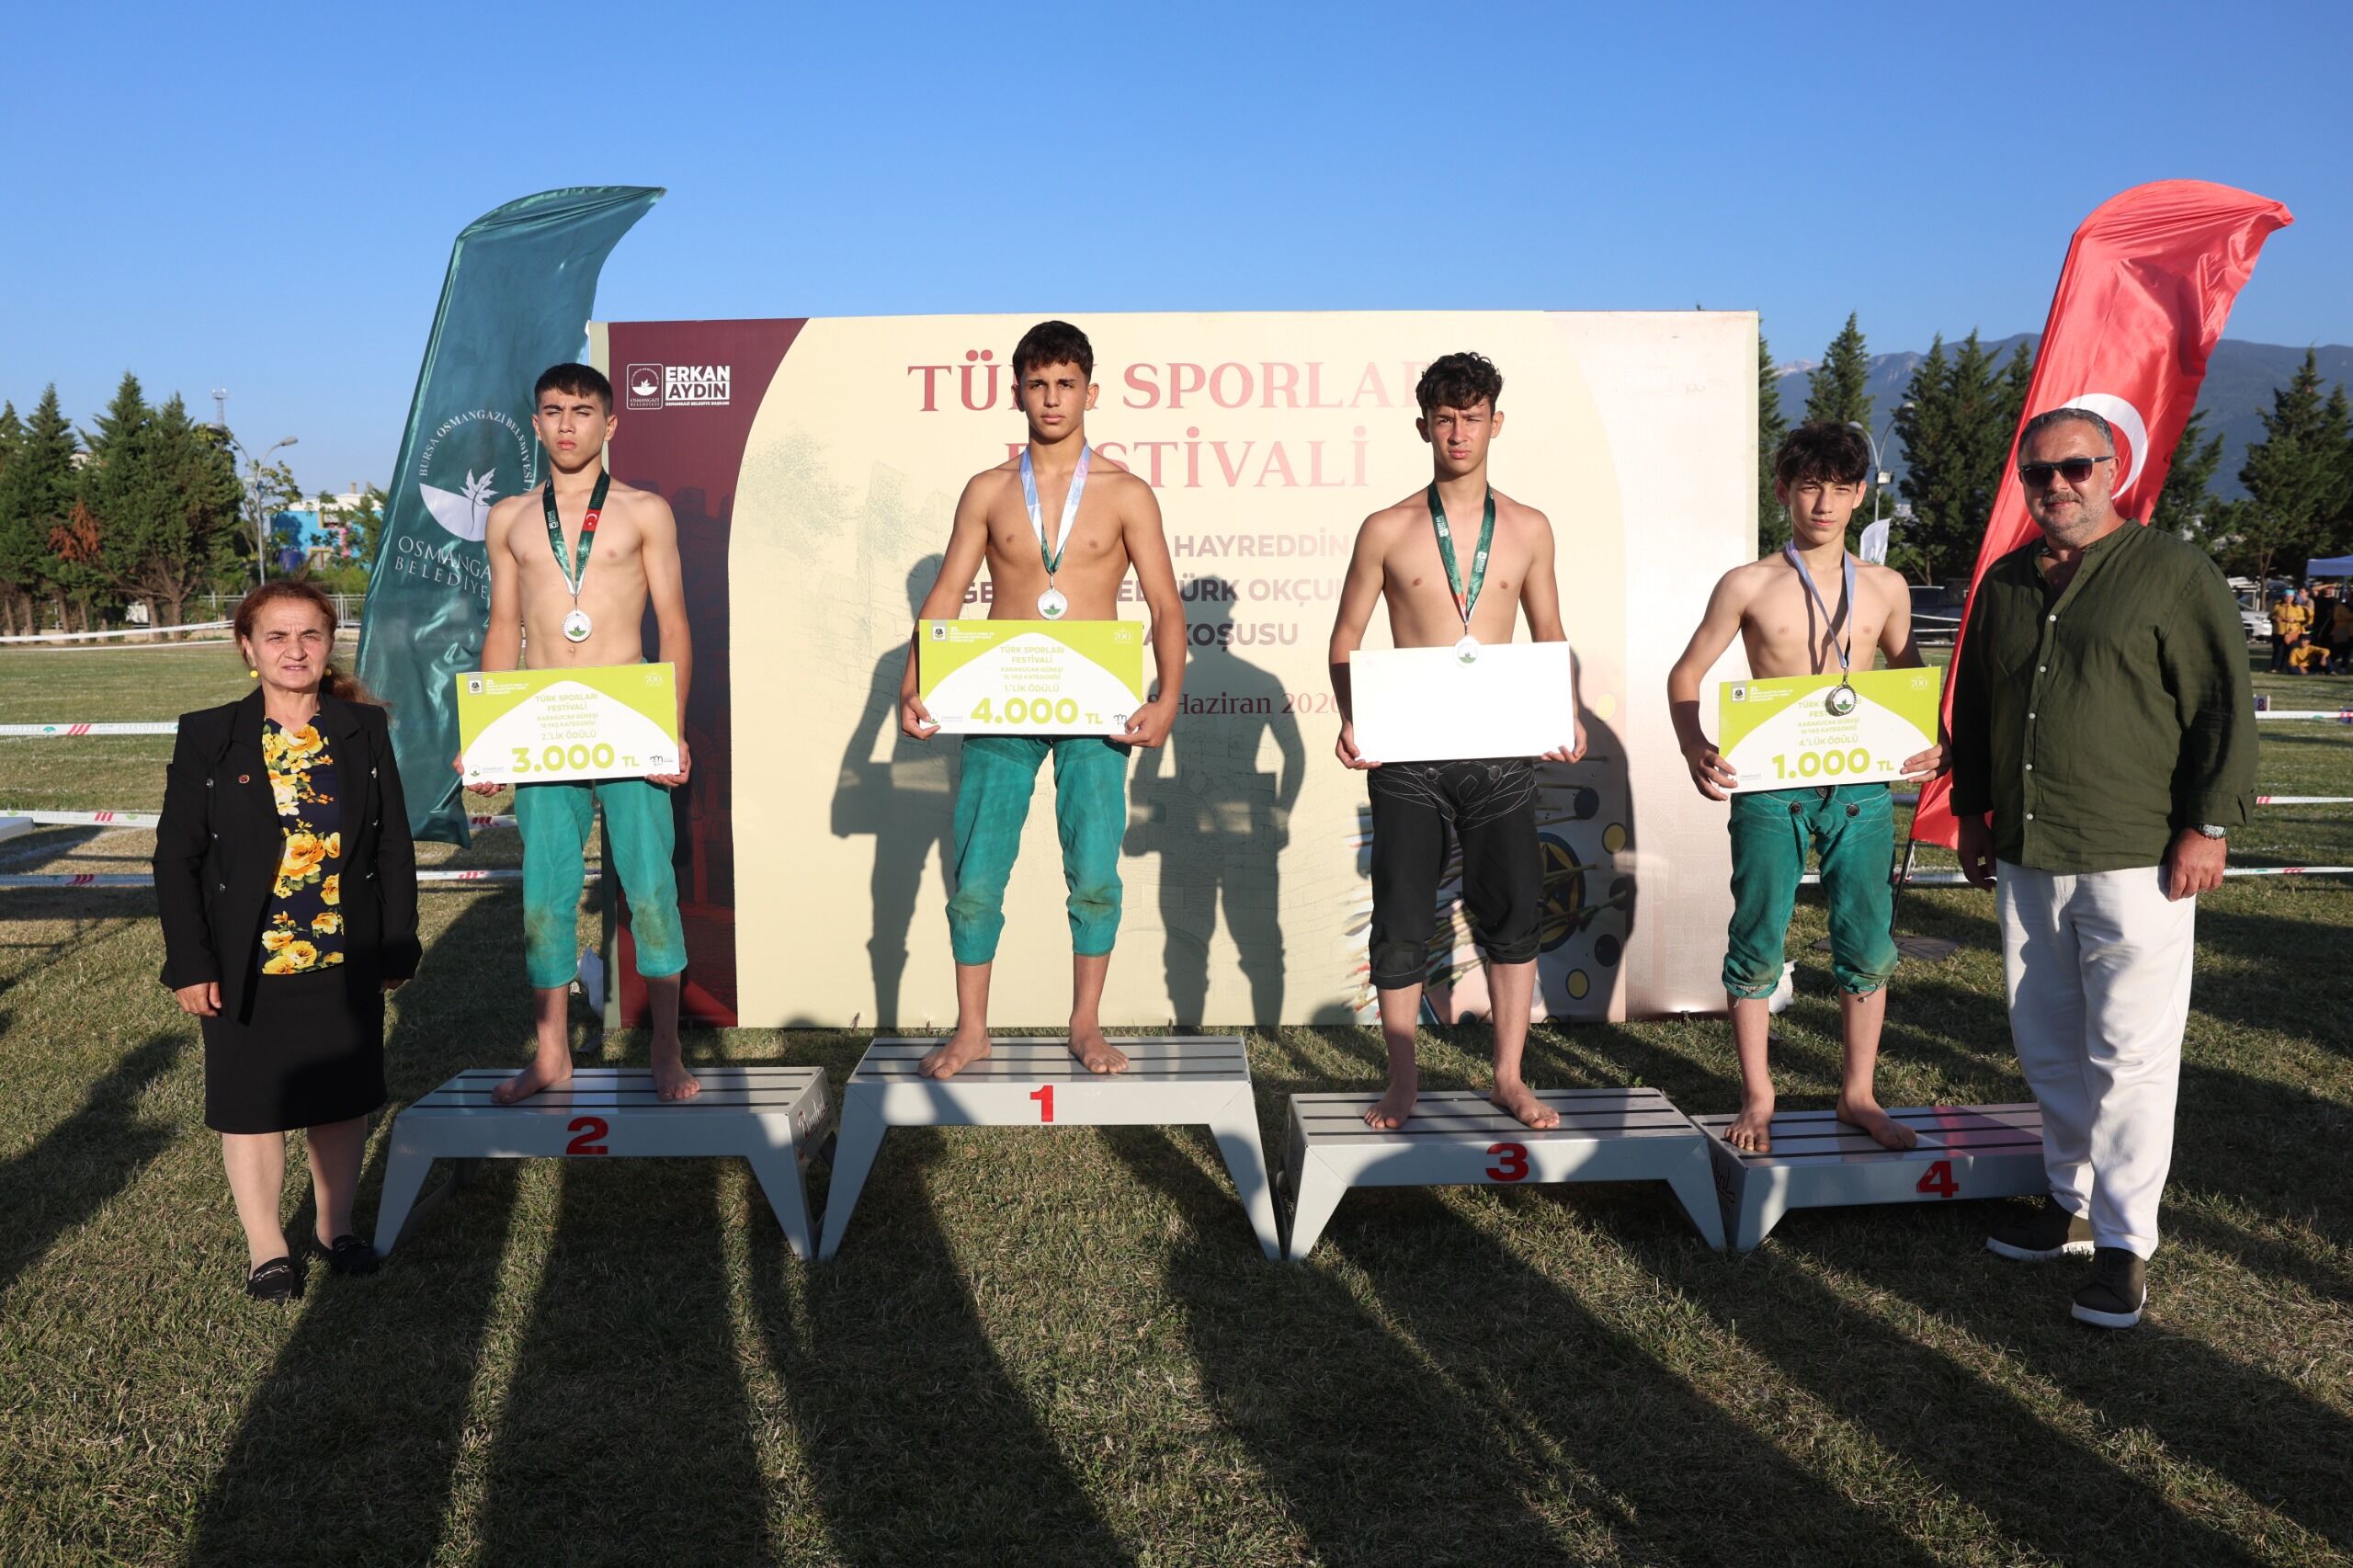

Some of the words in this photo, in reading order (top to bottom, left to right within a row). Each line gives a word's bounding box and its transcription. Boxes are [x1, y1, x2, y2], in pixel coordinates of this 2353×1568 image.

[665, 366, 731, 381] ERKAN
[1123, 360, 1431, 410] SPORLA
[668, 383, 726, 399] AYDIN
[419, 437, 440, 477] BURSA
[437, 409, 506, 438] OSMANGAZİ
[1005, 425, 1370, 488] TİVALİ
[1174, 528, 1349, 557] HAYREDDİN
[398, 536, 491, 583] OSMANGA
[1177, 573, 1240, 602] ÜRK
[1000, 644, 1022, 654] TÜRK
[1023, 645, 1065, 654] SPORLARI
[1011, 653, 1053, 665] FESTİVALİ
[536, 694, 557, 703] TÜRK
[558, 692, 597, 702] SPORLARI
[1028, 683, 1060, 692] ÖDÜLÜ
[547, 702, 587, 712] FESTİVALİ
[971, 698, 1078, 724] 4.000
[1086, 712, 1103, 724] TL
[1176, 692, 1271, 715] Haziran
[1798, 699, 1820, 709] TÜRK
[565, 730, 597, 740] ÖDÜLÜ
[1827, 734, 1859, 744] ÖDÜLÜ
[511, 743, 614, 773] 3.000
[621, 756, 640, 767] TL
[1772, 748, 1870, 779] 1.000
[1877, 760, 1894, 771] TL
[1030, 1085, 1053, 1122] 1
[566, 1117, 608, 1154] 2
[1485, 1142, 1529, 1182] 3
[1916, 1161, 1959, 1199] 4
